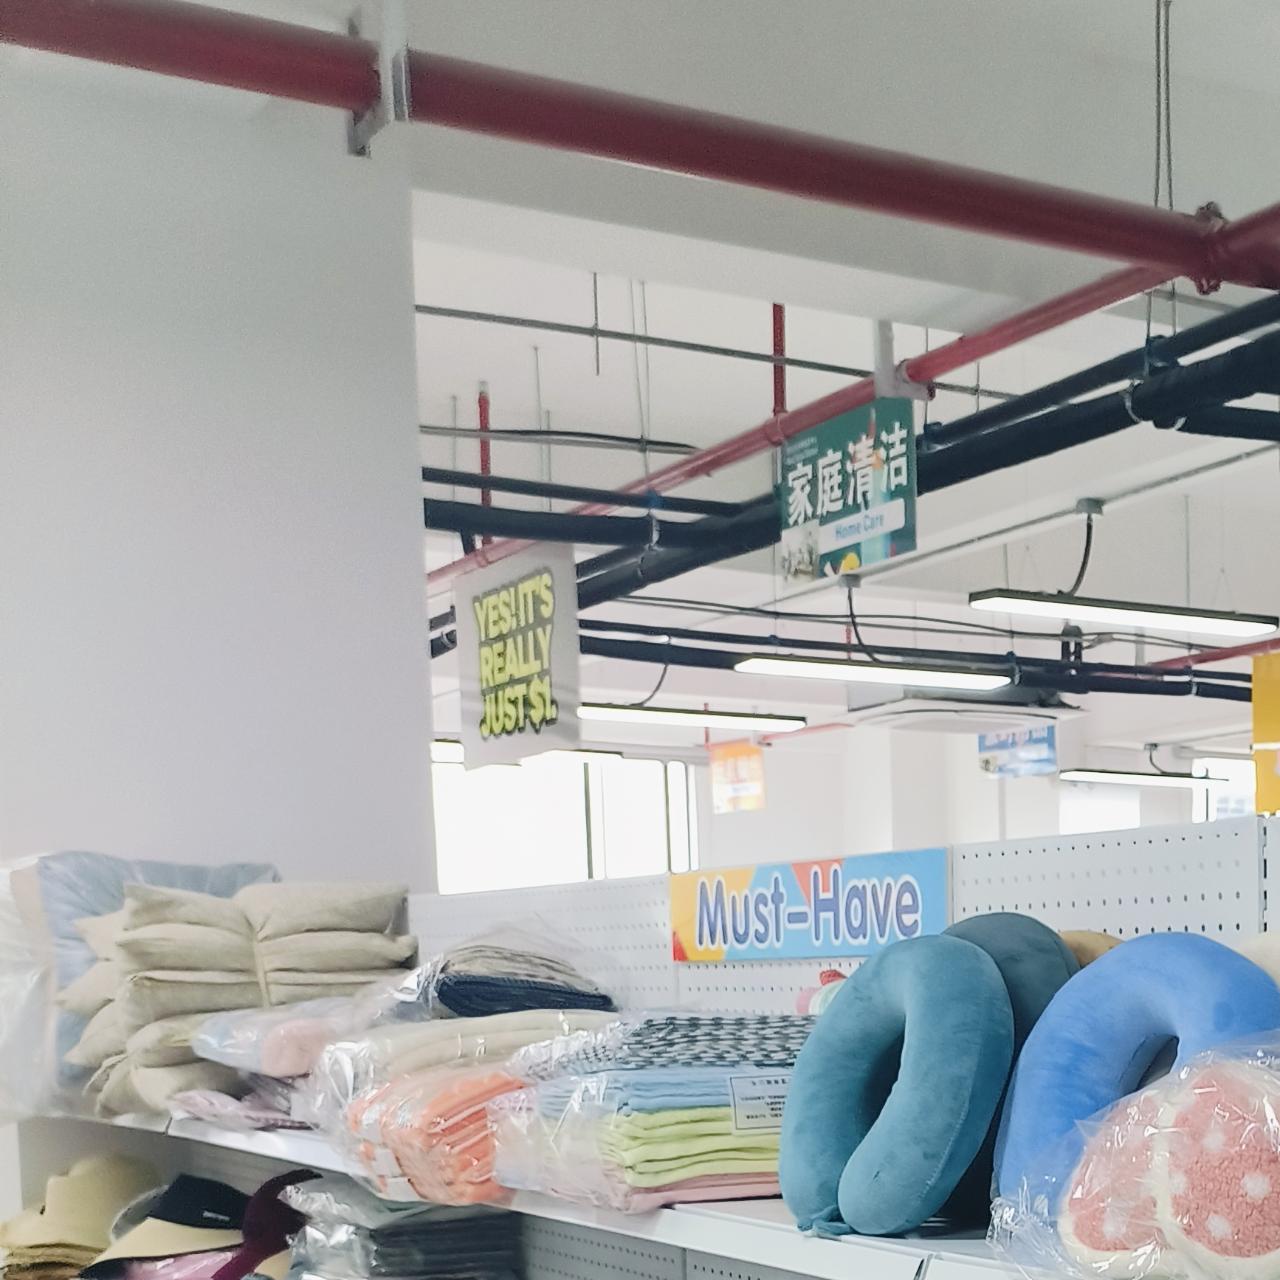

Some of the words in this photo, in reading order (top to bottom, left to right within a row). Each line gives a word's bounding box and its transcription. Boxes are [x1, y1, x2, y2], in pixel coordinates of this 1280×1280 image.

[787, 421, 908, 527] 家庭清洁
[480, 624, 552, 689] REALLY
[480, 684, 526, 738] JUST
[697, 867, 920, 947] Must-Have
